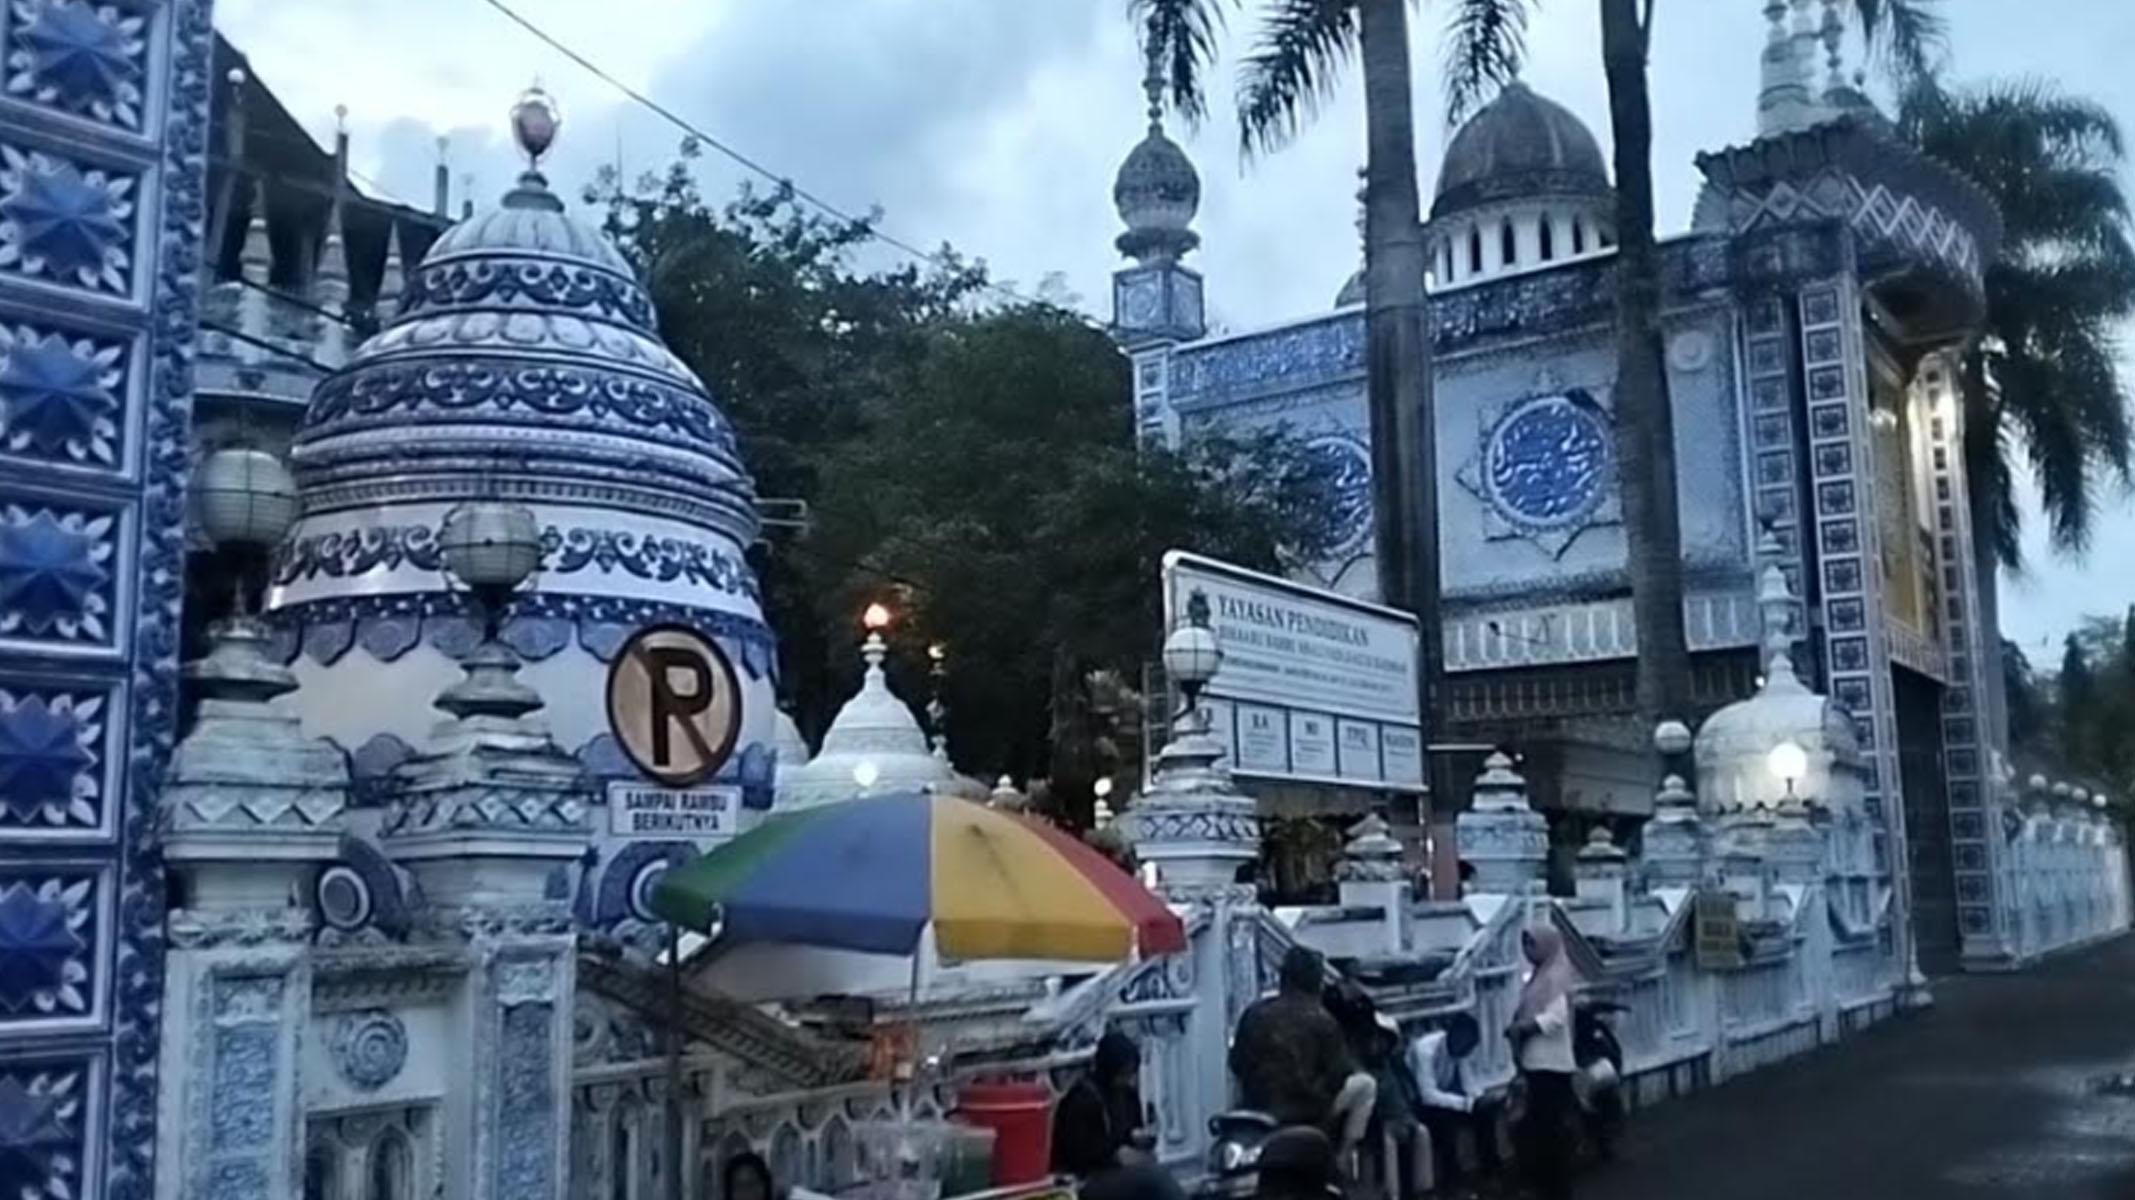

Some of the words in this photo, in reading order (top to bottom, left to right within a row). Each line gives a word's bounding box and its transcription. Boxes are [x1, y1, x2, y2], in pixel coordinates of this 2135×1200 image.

[1218, 595, 1285, 628] YAYASAN
[625, 791, 676, 811] SAMPAI
[680, 791, 728, 811] RAMBU
[632, 812, 720, 832] BERIKUTNYA
